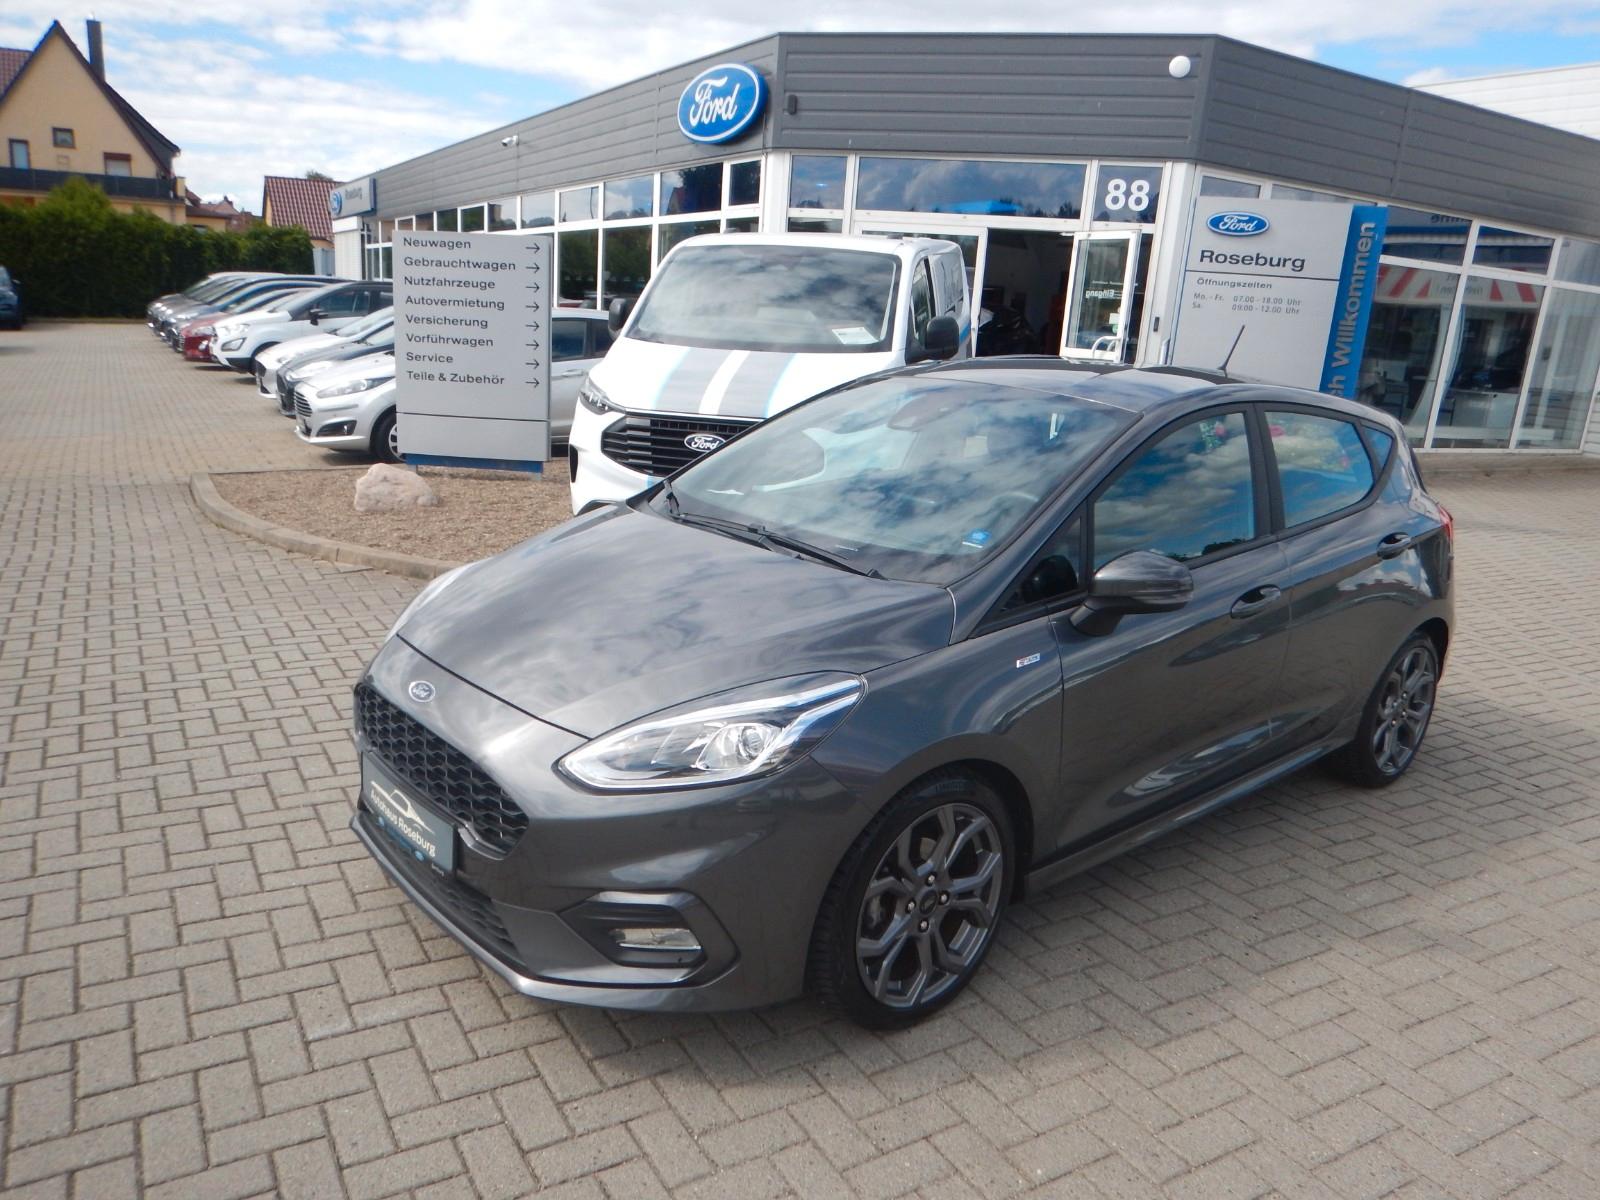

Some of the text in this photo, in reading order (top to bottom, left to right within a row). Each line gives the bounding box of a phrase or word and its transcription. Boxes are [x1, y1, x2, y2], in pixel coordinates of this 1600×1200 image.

[689, 75, 740, 127] Ford
[1105, 178, 1150, 211] 88
[403, 237, 472, 250] Neuwagen
[404, 256, 516, 271] Gebrauchtwagen
[1199, 250, 1306, 272] Roseburg
[404, 276, 496, 290] Nutzfahrzeuge
[1196, 277, 1273, 289] Öffnungszeiten
[1331, 222, 1376, 368] Willkommen
[405, 295, 505, 311] Autovermietung
[405, 314, 488, 329] Versicherung
[406, 333, 494, 347] Vorführwagen
[406, 352, 454, 363] Service
[406, 370, 505, 385] Teile & Zubehör
[398, 817, 437, 857] Roseburg
